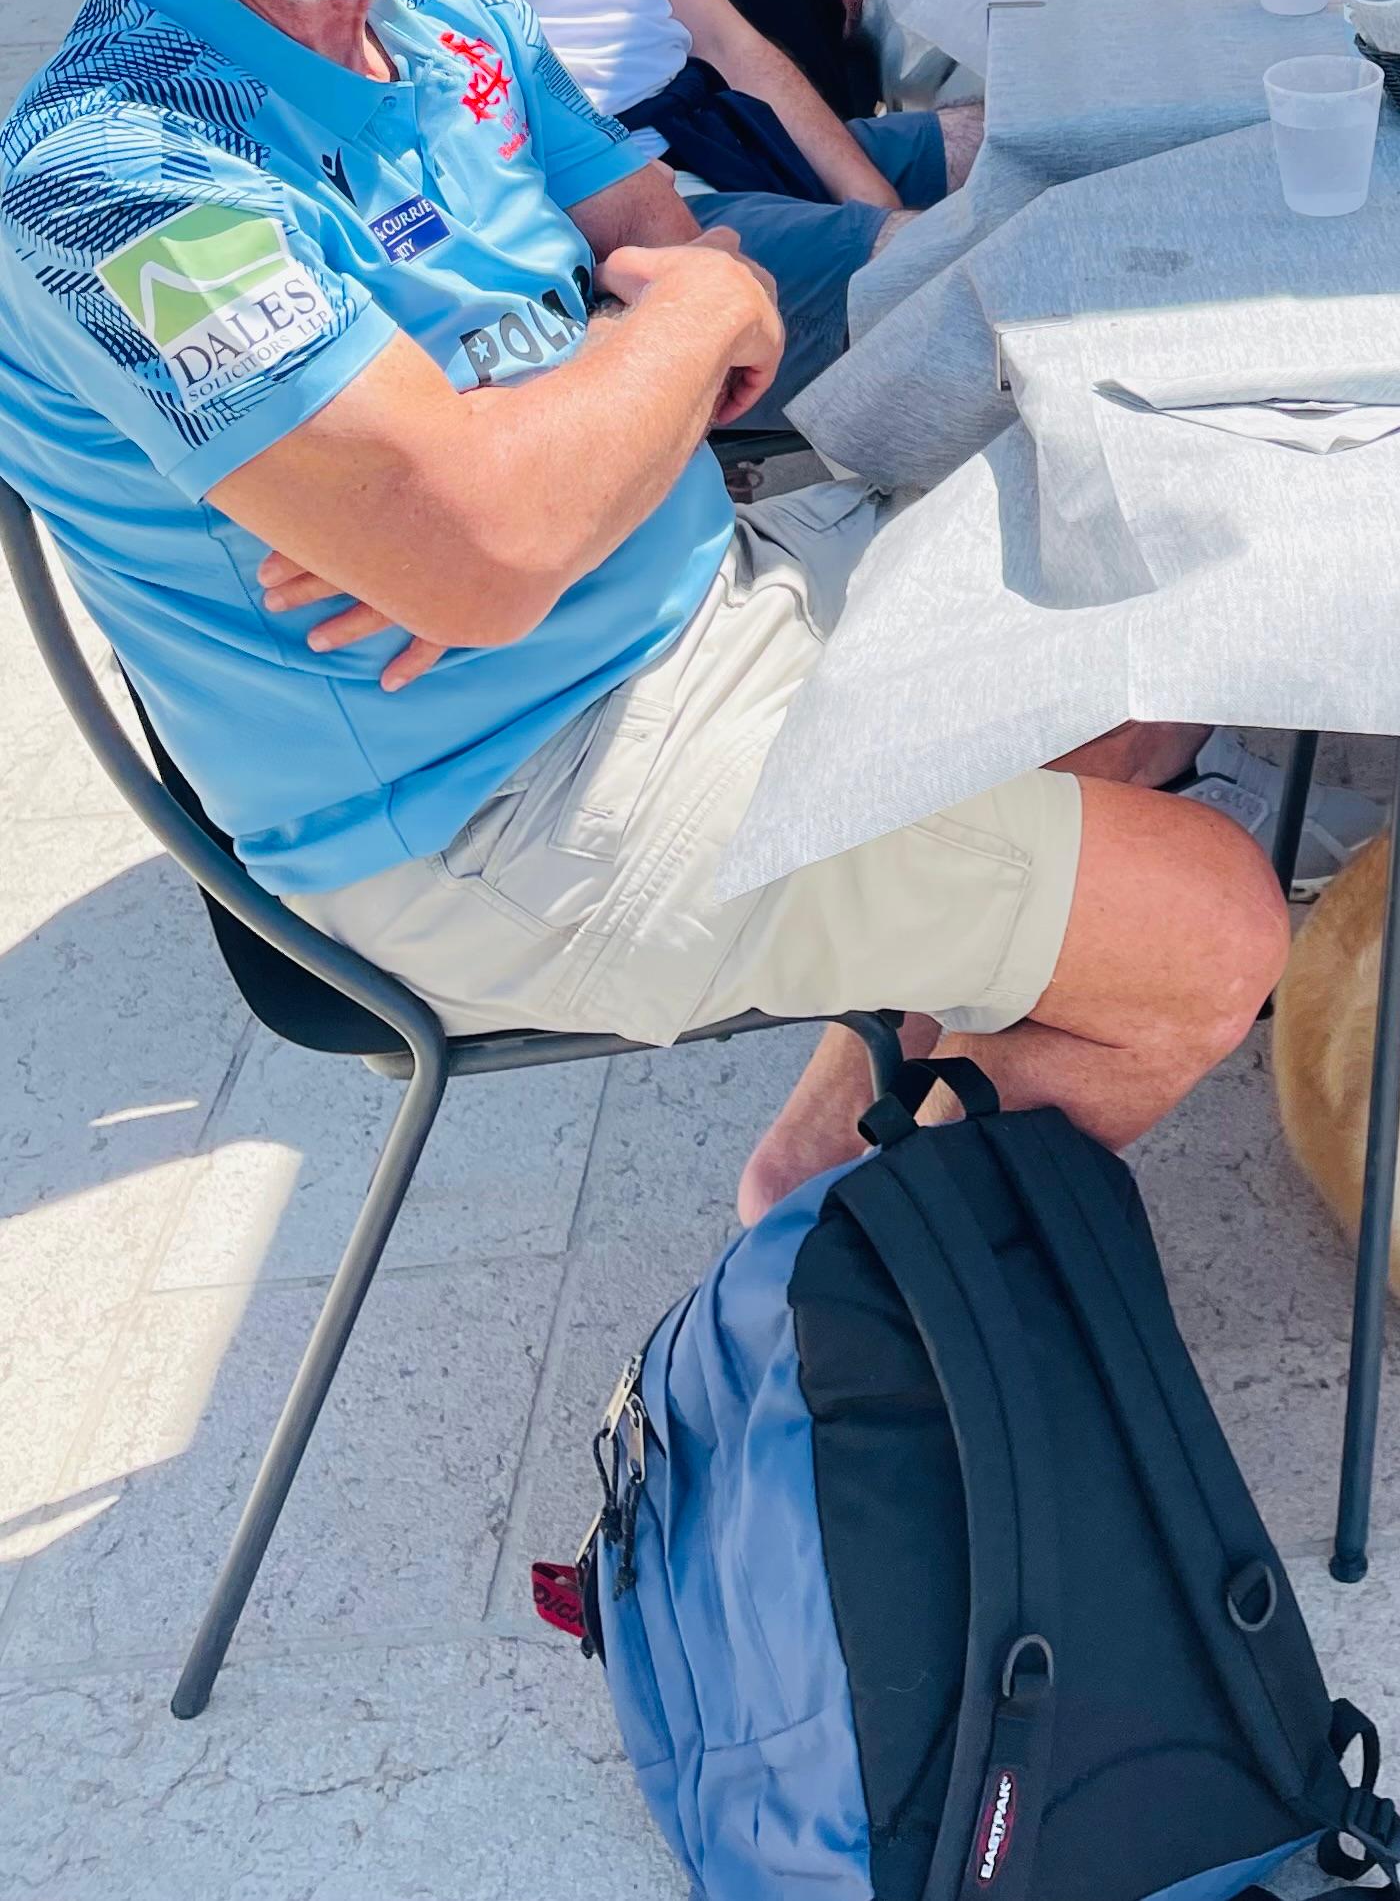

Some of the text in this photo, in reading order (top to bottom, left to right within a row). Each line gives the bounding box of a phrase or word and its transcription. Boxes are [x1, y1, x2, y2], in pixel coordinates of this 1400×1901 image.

[382, 199, 432, 236] CURRIE
[171, 278, 317, 389] DALES
[189, 310, 328, 402] SOLICITORS LLP
[980, 1782, 1012, 1879] EASTPAK
